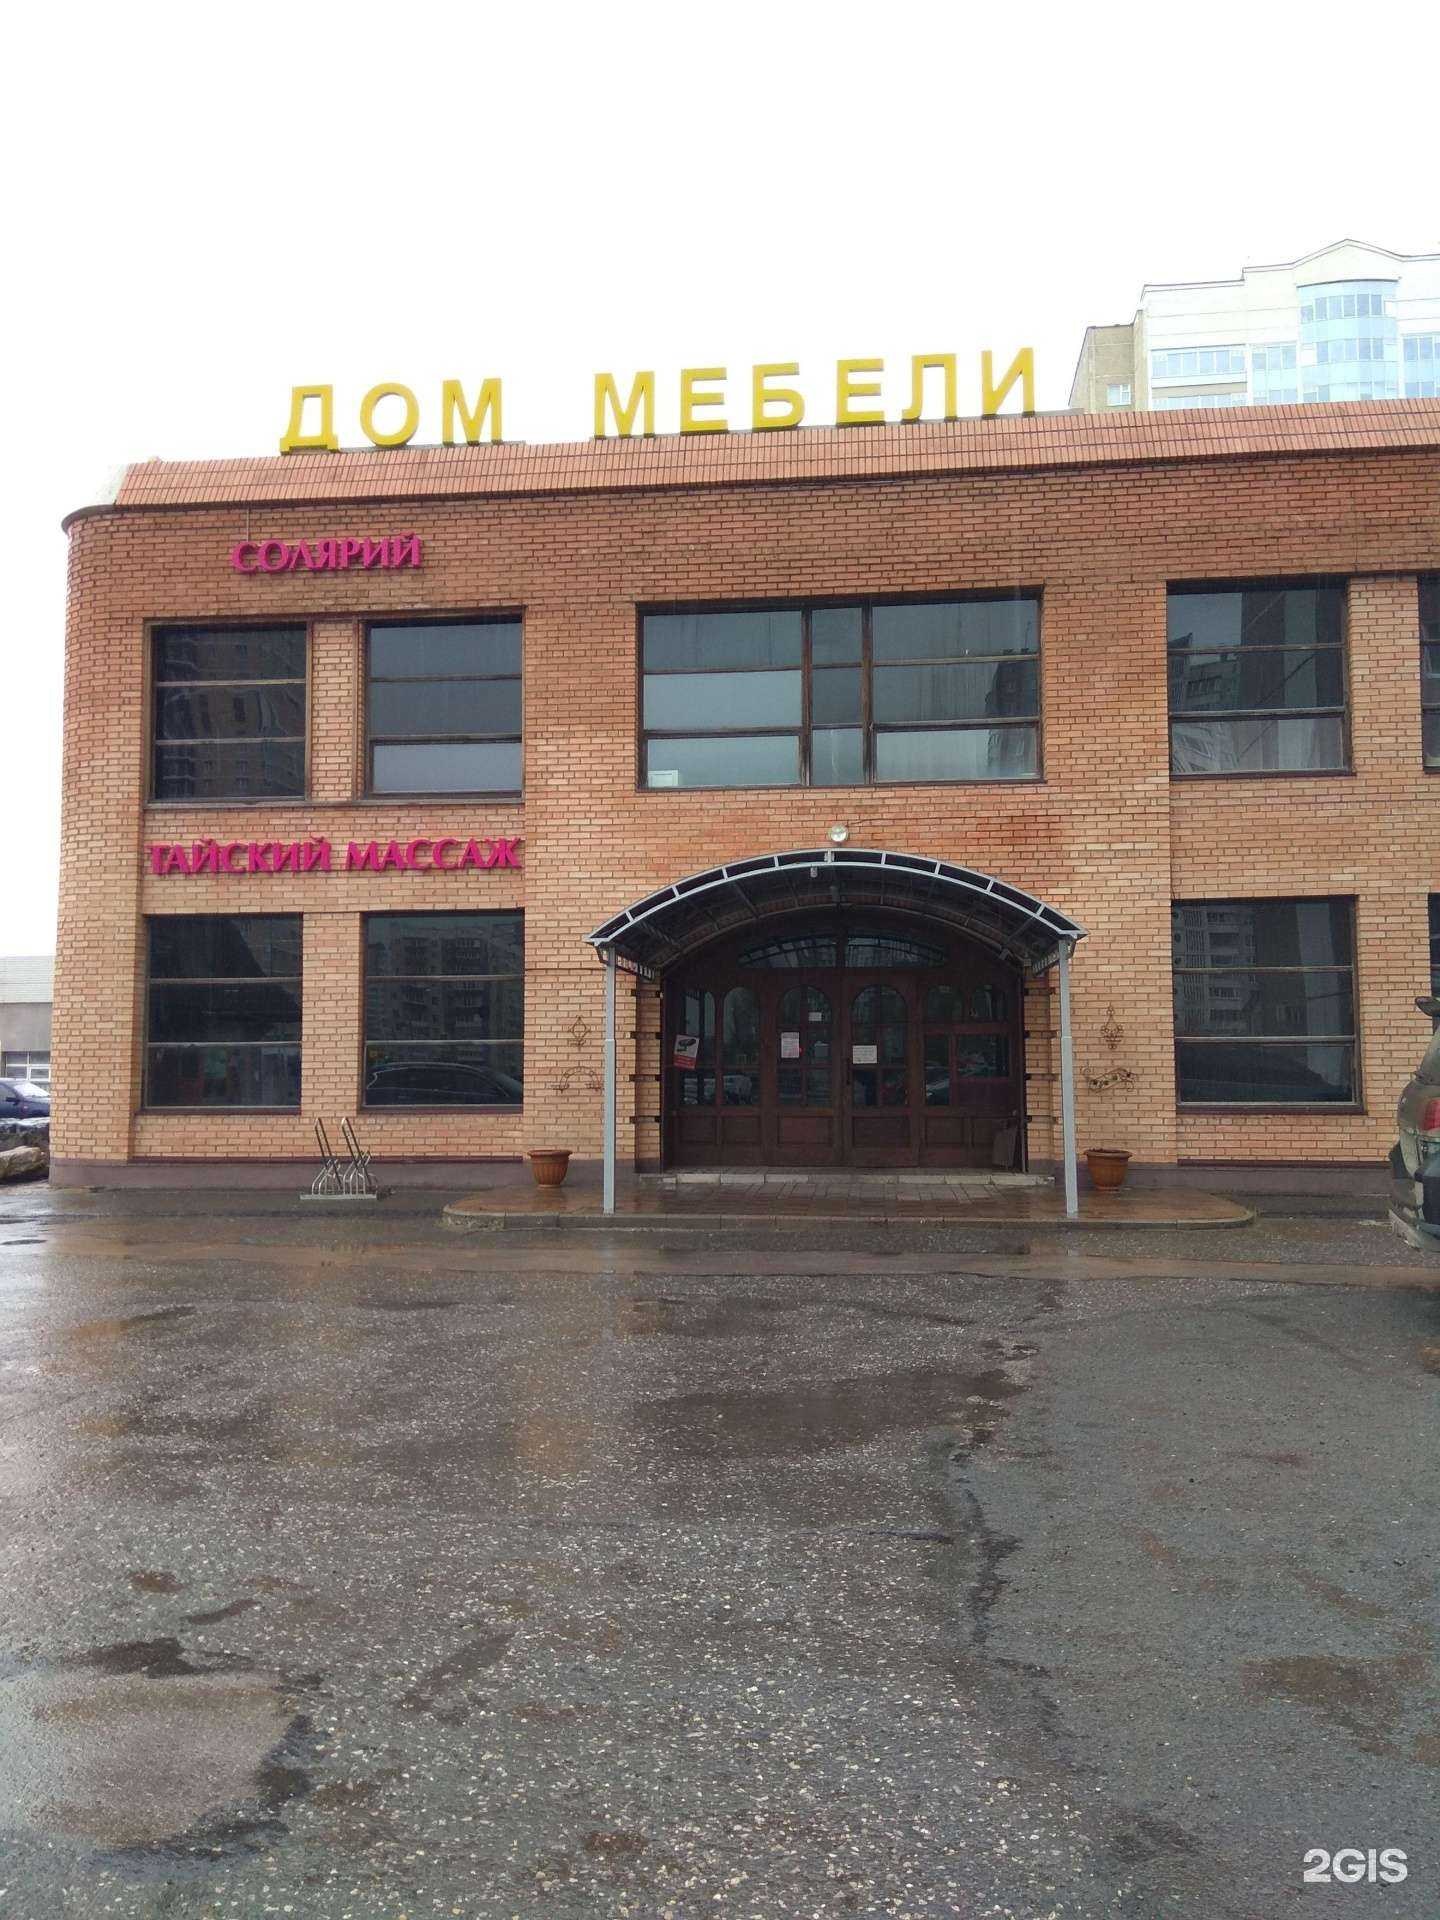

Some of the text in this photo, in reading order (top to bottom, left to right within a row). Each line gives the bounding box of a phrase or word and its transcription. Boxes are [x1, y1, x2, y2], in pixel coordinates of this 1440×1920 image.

[280, 347, 1035, 455] ДОМ МЕБЕЛИ
[231, 532, 422, 574] СОЛЯРИЙ
[149, 833, 522, 875] ТАЙСКИЙ МАССАЖ
